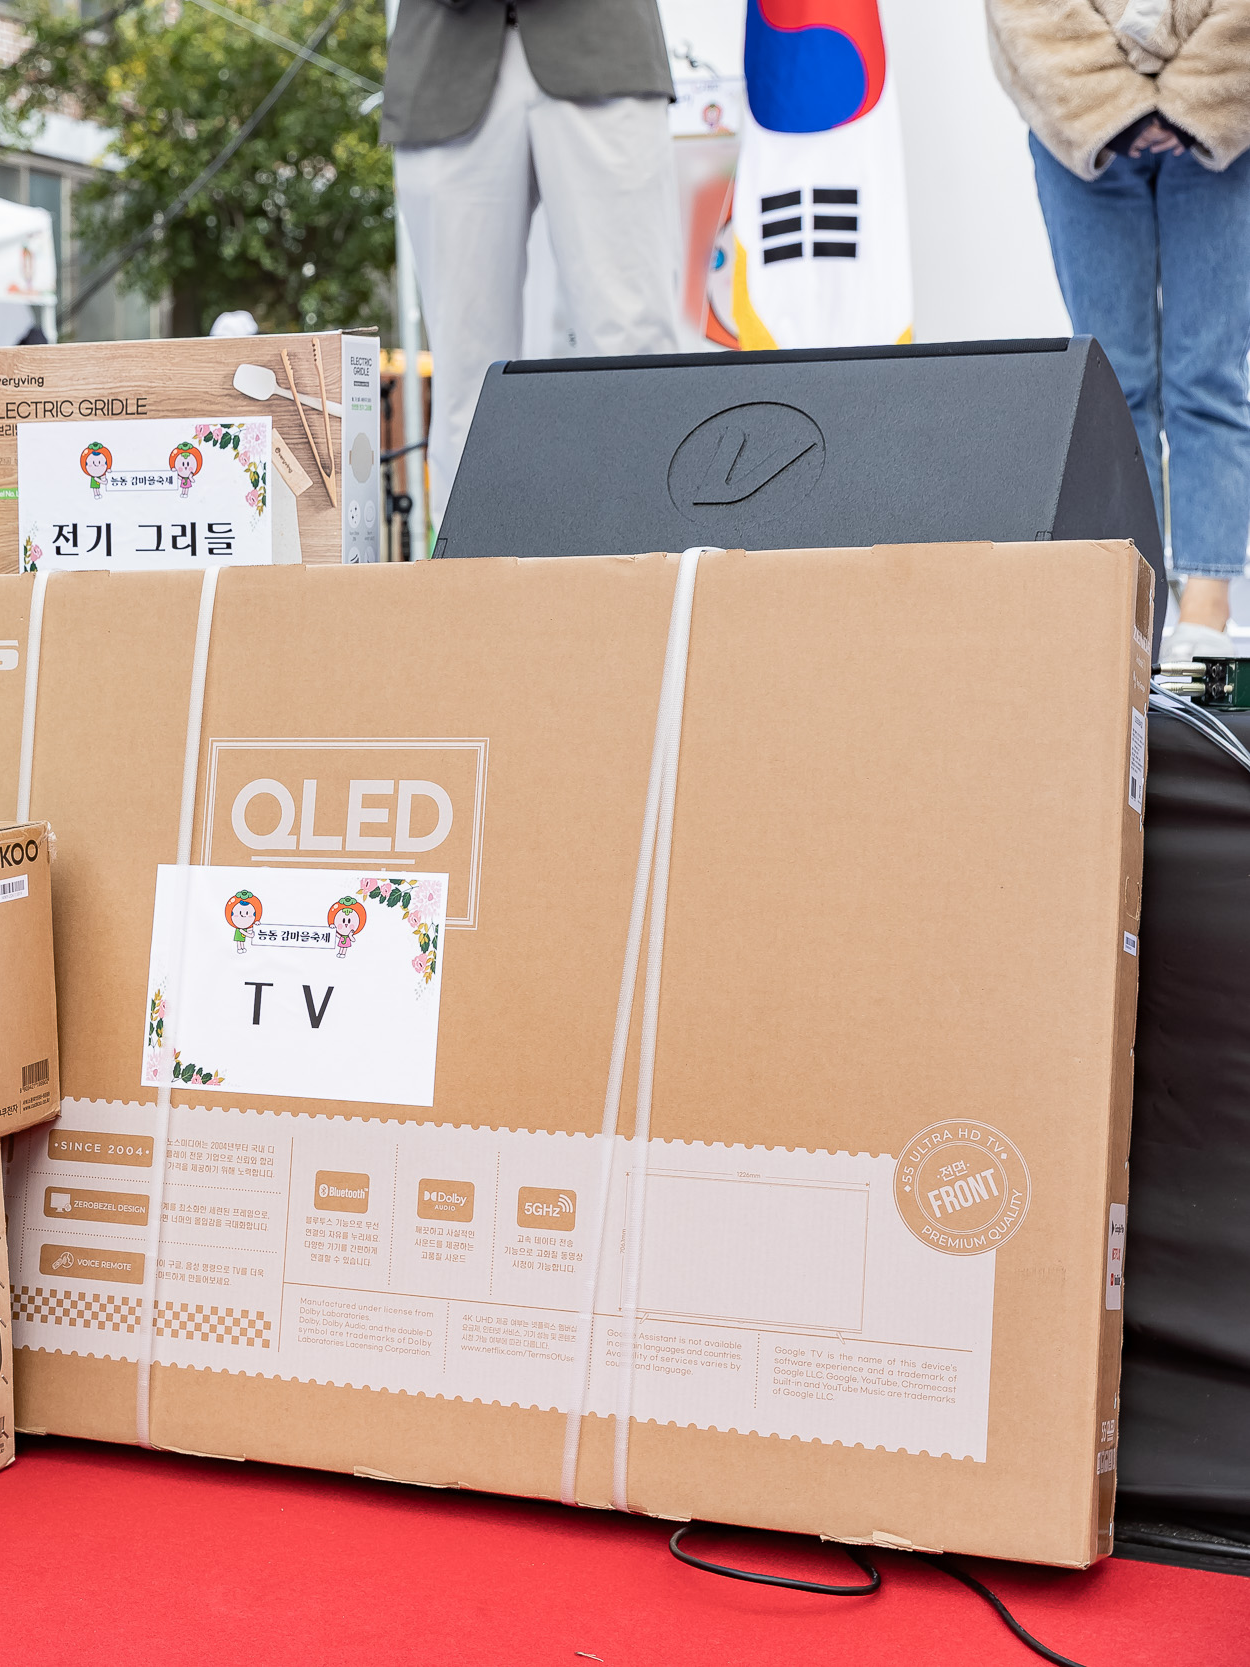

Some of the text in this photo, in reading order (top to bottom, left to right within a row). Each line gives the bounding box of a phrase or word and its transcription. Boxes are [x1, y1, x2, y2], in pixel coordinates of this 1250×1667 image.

[78, 398, 148, 417] GRIDLE
[52, 521, 236, 557] 전기 그리들
[230, 778, 455, 855] QLED
[258, 929, 331, 945] 능동 감마을축제
[60, 1140, 143, 1157] SINCE 2004
[902, 1128, 1005, 1183] 55 ULTRA HD TV
[939, 1160, 968, 1182] 전면
[438, 1192, 467, 1207] Dolby
[927, 1168, 999, 1218] FRONT
[73, 1200, 146, 1214] ZEROBEZEL DESIGN
[524, 1202, 561, 1217] 5GHz
[921, 1188, 1023, 1249] PREMIUM QUALITY
[76, 1258, 132, 1271] VOICE REMOTE
[774, 1346, 957, 1372] Google TV is the name of this device's
[774, 1357, 812, 1368] software
[816, 1362, 864, 1374] experience
[868, 1366, 884, 1375] and
[897, 1370, 944, 1382] trademark
[948, 1374, 957, 1383] of
[773, 1377, 956, 1404] built-in and YouTube Music are trademarks
[774, 1367, 804, 1378] Google
[901, 1380, 957, 1393] Chromecast
[783, 1388, 814, 1400] Google
